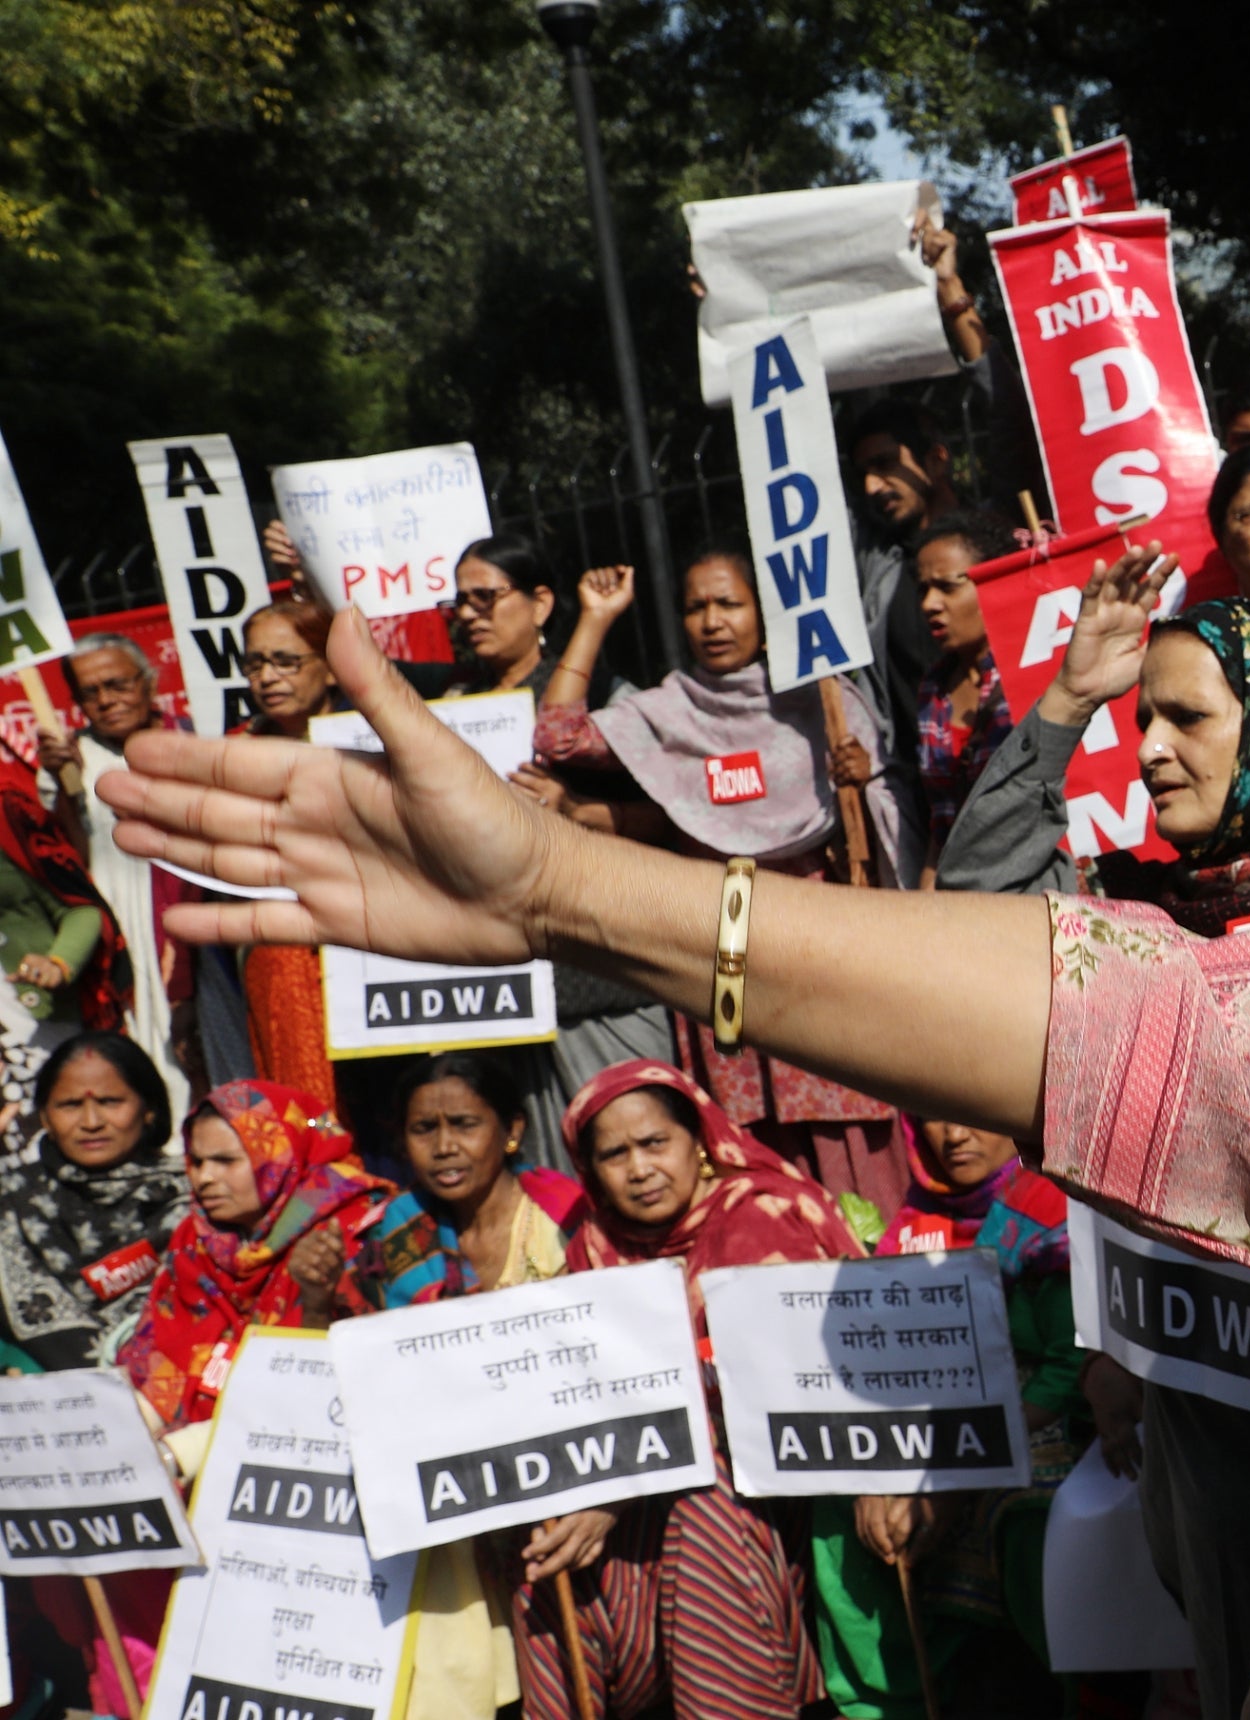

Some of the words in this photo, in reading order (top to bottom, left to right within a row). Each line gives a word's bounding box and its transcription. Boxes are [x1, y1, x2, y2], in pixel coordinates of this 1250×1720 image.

[1051, 241, 1128, 286] ALL
[1035, 286, 1160, 340] INDIA
[752, 335, 850, 678] AIDWA
[342, 557, 447, 601] PMS
[368, 984, 519, 1021] AIDWA
[779, 1289, 873, 1309] बलात्कार
[881, 1281, 910, 1308] की
[395, 1323, 485, 1358] लगातार
[490, 1302, 596, 1337] बलात्कार
[839, 1322, 886, 1350] मोदी
[894, 1326, 971, 1349] सरकार
[482, 1350, 540, 1391] चुप्पी
[550, 1377, 602, 1407] मोदी
[608, 1367, 683, 1396] सरकार
[839, 1365, 855, 1390] है
[778, 1422, 986, 1461] AIDWA
[430, 1425, 671, 1511] AIDWA
[4, 1512, 162, 1551] AIDWA
[363, 1573, 390, 1601] की
[273, 1606, 316, 1638] सुरक्षा
[348, 1657, 385, 1685] करो
